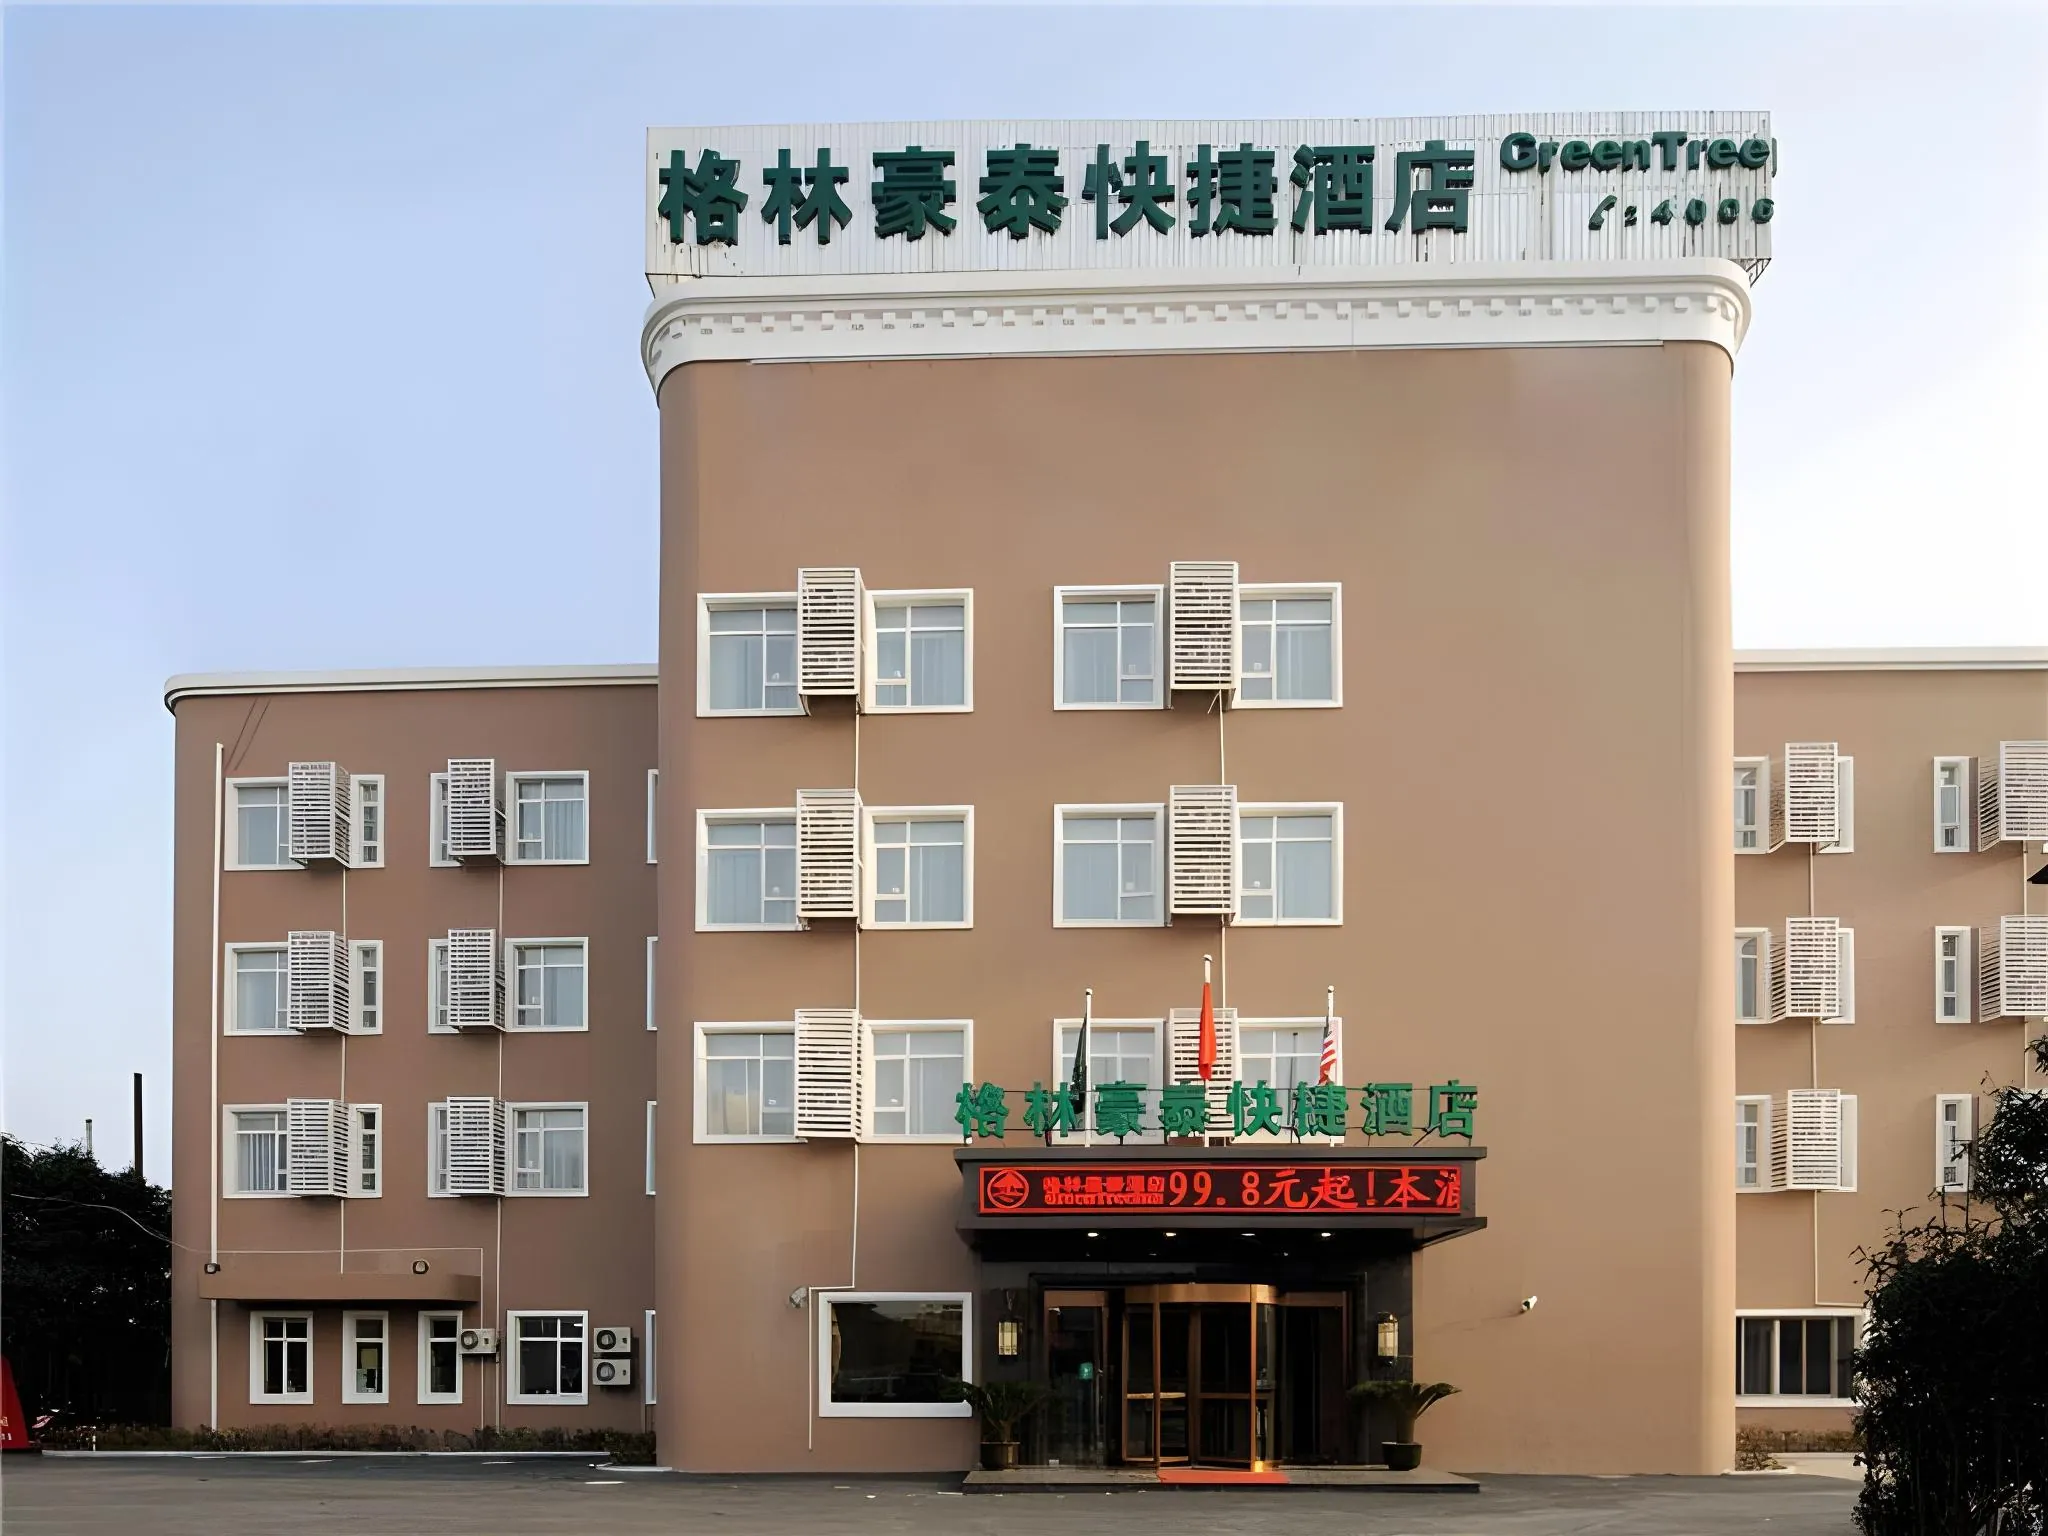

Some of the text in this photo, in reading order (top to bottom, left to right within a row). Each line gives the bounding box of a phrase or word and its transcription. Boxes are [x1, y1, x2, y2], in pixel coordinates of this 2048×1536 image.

[1500, 131, 1770, 173] GreenTree
[658, 140, 1476, 246] 格林豪泰快捷酒店
[956, 1079, 1478, 1140] 格林豪泰快捷酒店
